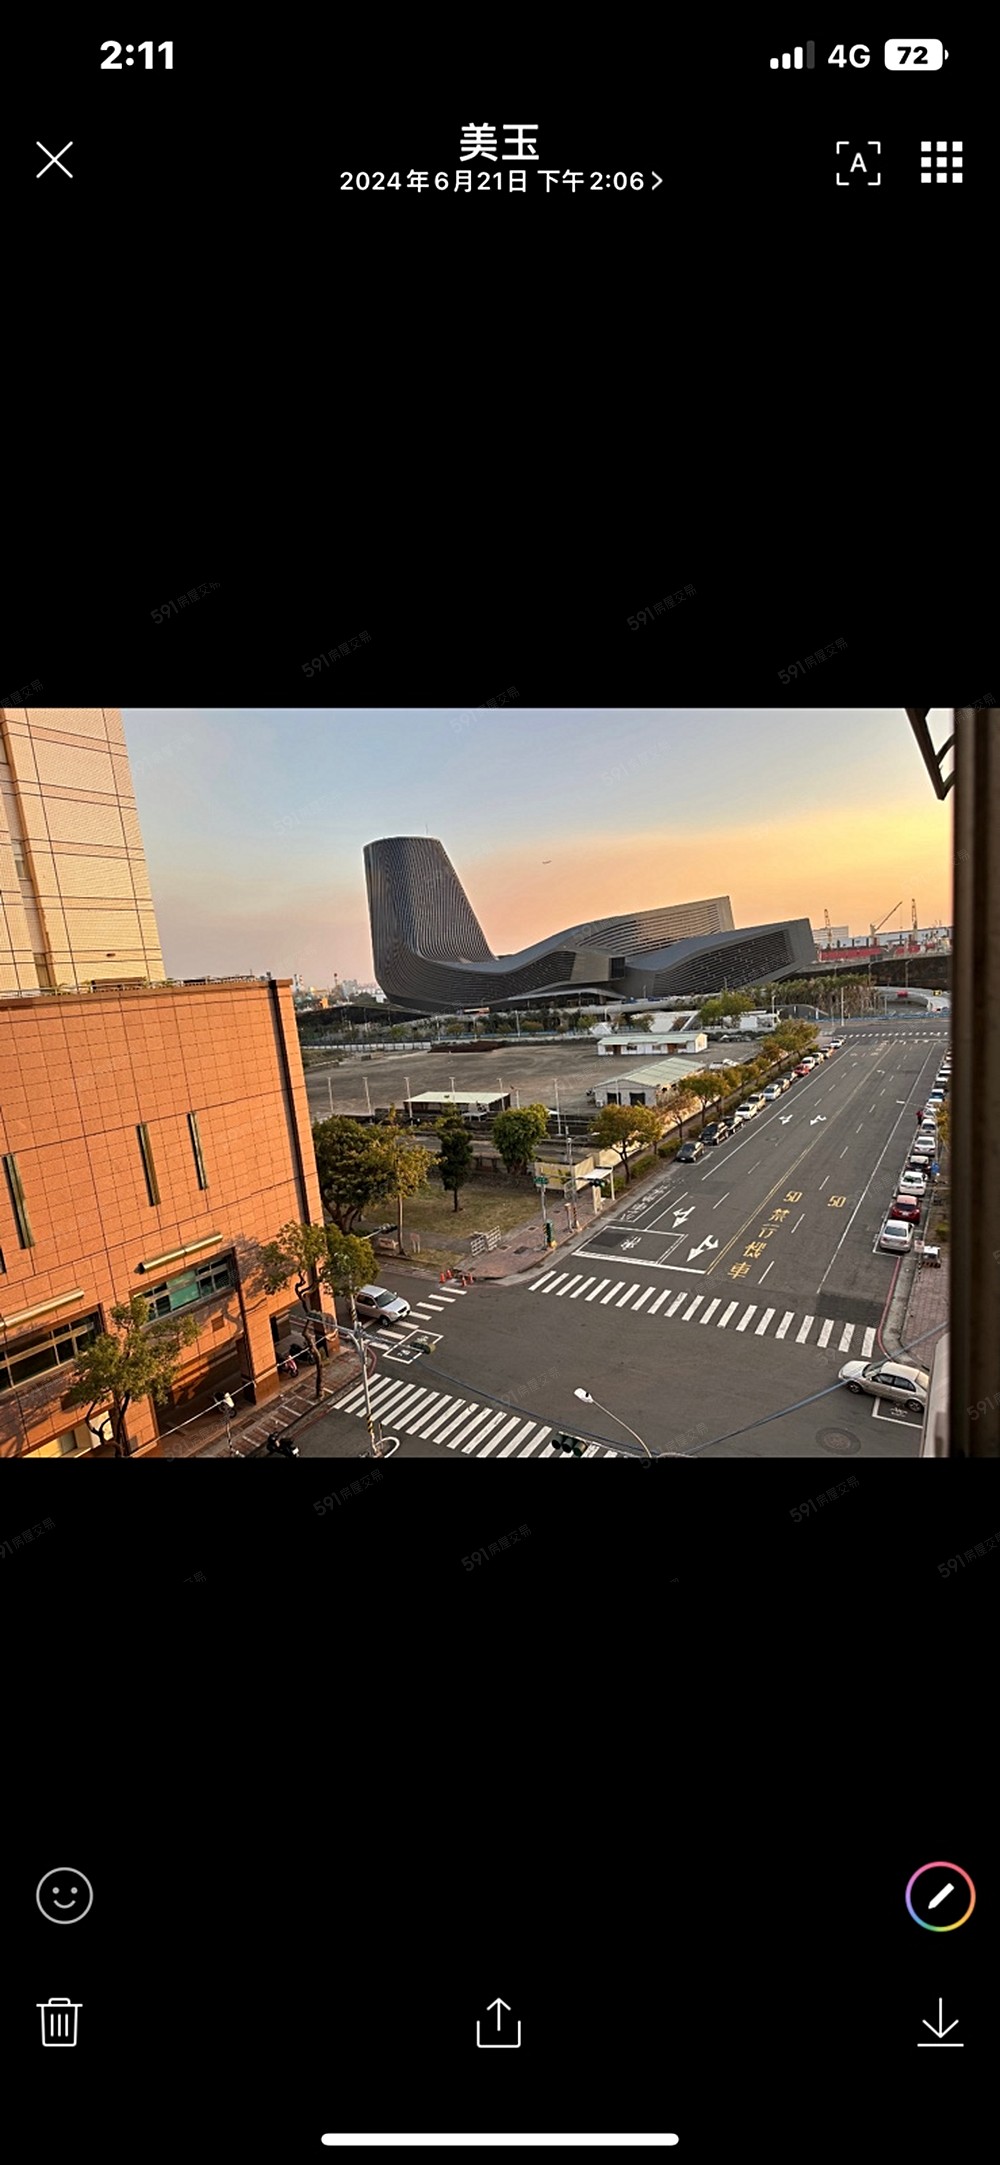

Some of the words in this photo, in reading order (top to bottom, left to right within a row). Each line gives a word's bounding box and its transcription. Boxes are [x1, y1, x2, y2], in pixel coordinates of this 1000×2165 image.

[99, 39, 174, 70] 2:11
[827, 43, 871, 69] 4G
[897, 45, 929, 65] 72
[459, 122, 540, 162] 美玉
[849, 152, 868, 173] A
[339, 168, 527, 193] 2024年6月21日
[536, 168, 645, 193] 下午2:06
[783, 1190, 803, 1203] 50
[827, 1195, 847, 1208] 50
